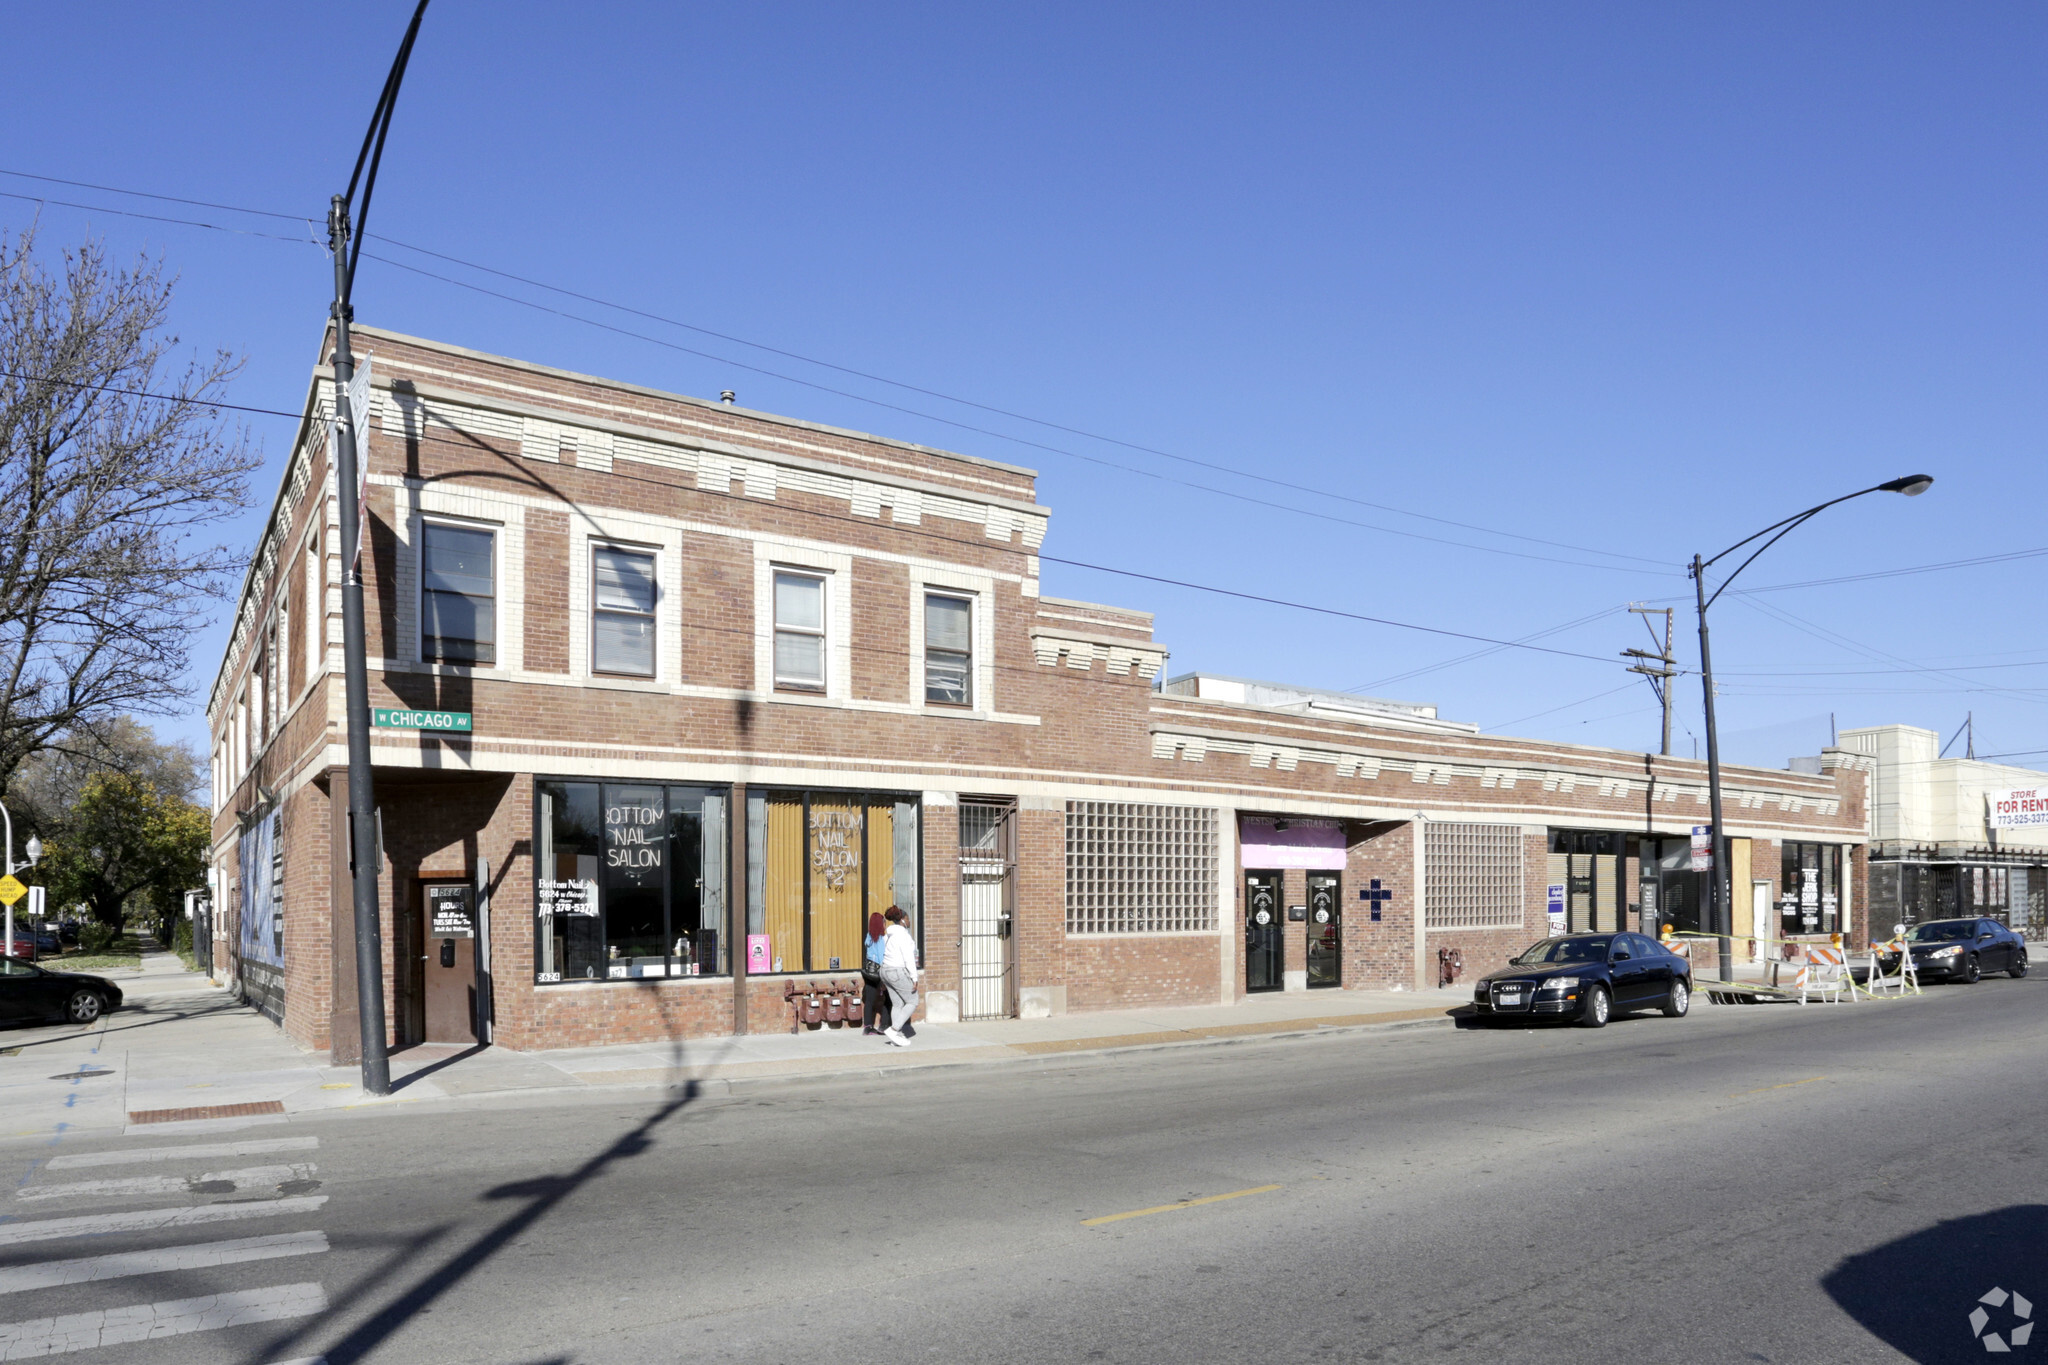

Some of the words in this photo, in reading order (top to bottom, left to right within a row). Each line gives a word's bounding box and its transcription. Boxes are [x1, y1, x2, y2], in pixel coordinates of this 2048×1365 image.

[379, 713, 386, 722] W
[390, 711, 452, 728] CHICAGO
[456, 717, 467, 726] AV
[2010, 790, 2037, 799] STORE
[1996, 800, 2018, 814] FOR
[2021, 798, 2048, 812] RENT
[809, 811, 863, 830] BOTTOM
[614, 827, 651, 846] NAIL
[819, 830, 850, 848] NAIL
[607, 848, 661, 867] SALON
[813, 850, 858, 867] SALON
[825, 868, 845, 885] #2
[1804, 872, 1817, 882] THE
[440, 889, 461, 897] 5624
[1801, 892, 1818, 903] SHOP
[440, 901, 464, 911] HOURS
[538, 973, 560, 982] 5624
